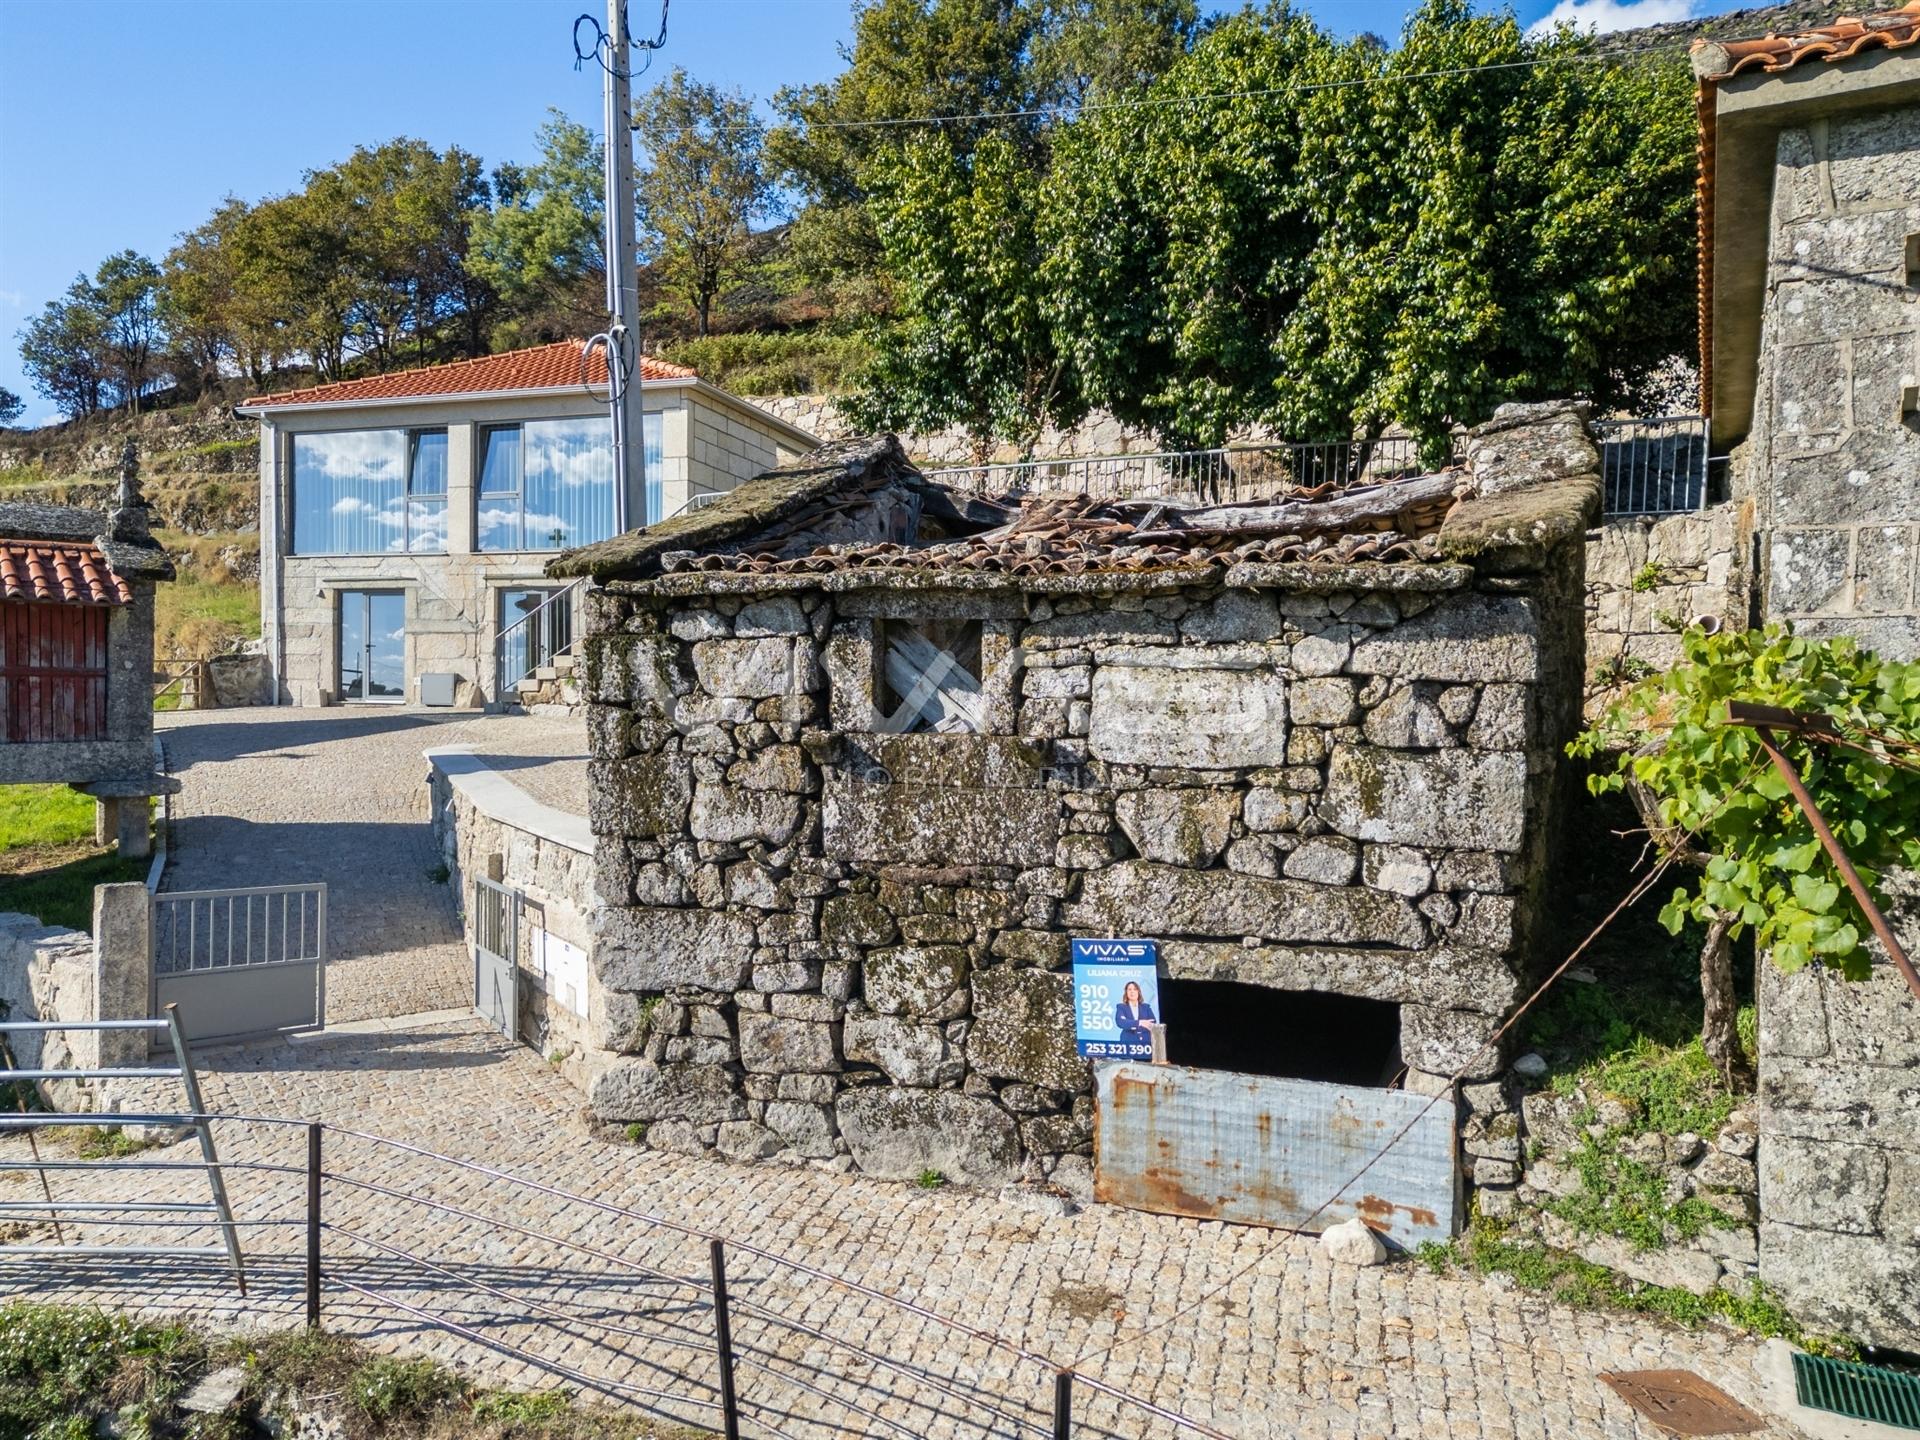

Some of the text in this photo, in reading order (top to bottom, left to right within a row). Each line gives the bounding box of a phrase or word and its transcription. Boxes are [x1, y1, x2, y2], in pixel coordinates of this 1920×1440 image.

[1079, 944, 1144, 956] VIVAS
[1087, 969, 1142, 977] LILIANA CRUZ
[1080, 984, 1109, 999] 910
[1081, 1000, 1114, 1015] 924
[1082, 1015, 1114, 1031] 550
[1086, 1043, 1152, 1055] 253 321 390
